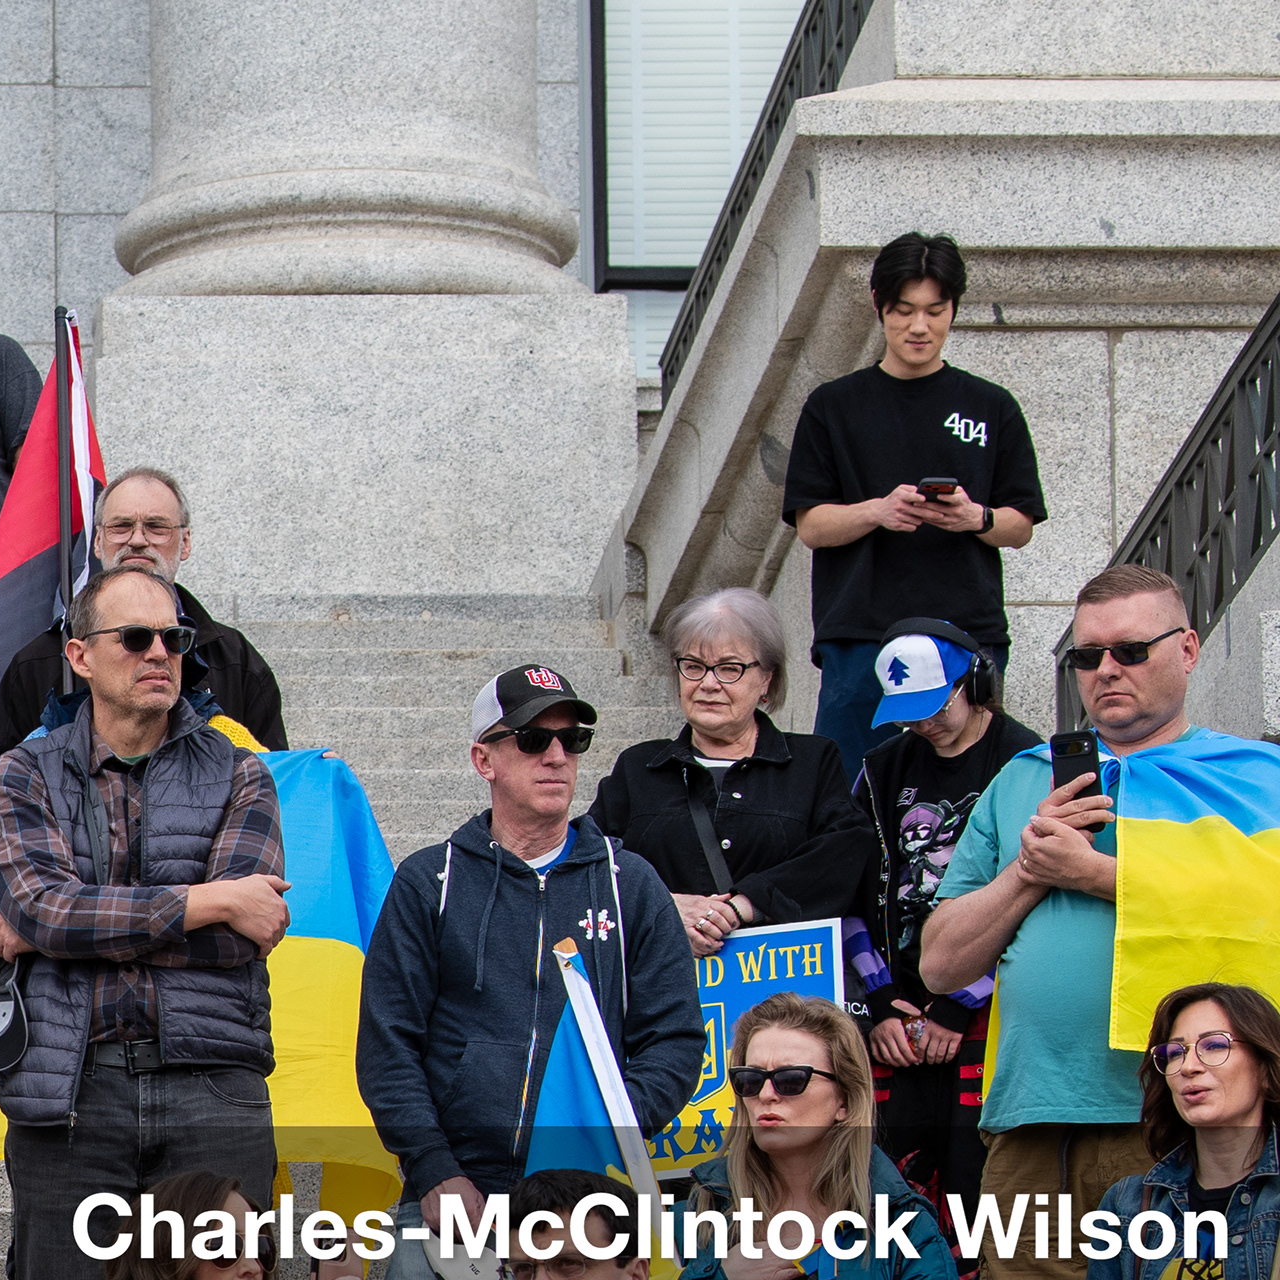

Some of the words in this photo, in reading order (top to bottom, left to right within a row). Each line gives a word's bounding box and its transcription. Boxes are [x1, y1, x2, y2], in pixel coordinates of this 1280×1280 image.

[943, 412, 988, 447] 404
[736, 942, 824, 983] WITH
[468, 1263, 481, 1276] TUG
